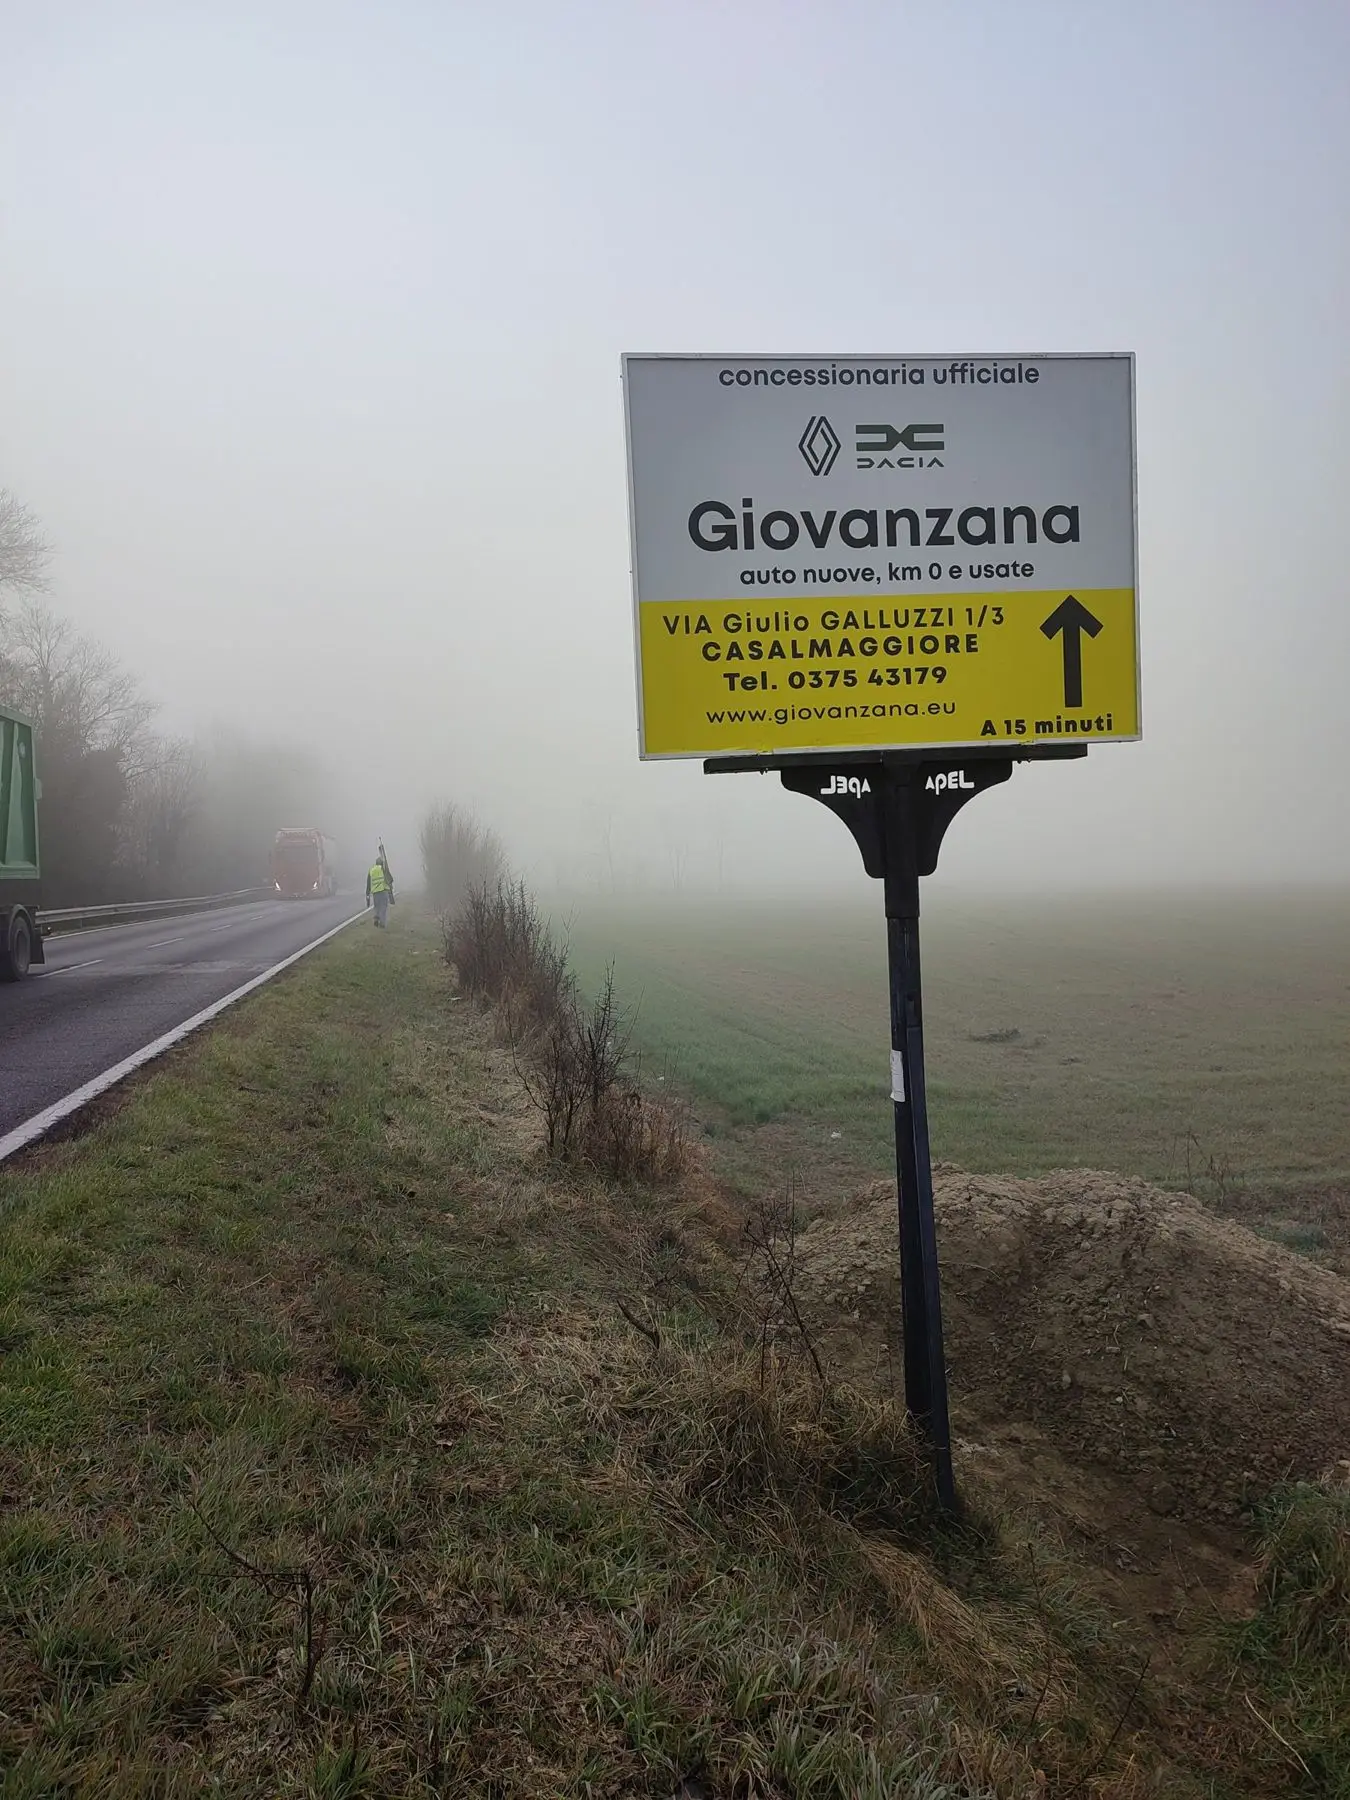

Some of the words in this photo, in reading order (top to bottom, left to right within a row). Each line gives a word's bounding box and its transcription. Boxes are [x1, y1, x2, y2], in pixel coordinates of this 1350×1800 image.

[718, 363, 925, 387] concessionaria
[932, 363, 1040, 385] ufficiale
[856, 457, 945, 470] DACIA
[687, 498, 1080, 552] Giovanzana
[739, 567, 797, 586] auto
[803, 568, 881, 585] nuove,
[888, 562, 922, 581] km
[928, 563, 942, 581] 0
[948, 565, 963, 580] e
[969, 561, 1035, 579] usate
[662, 615, 713, 635] VIA
[723, 611, 810, 634] Giulio
[820, 608, 954, 631] GALLUZZI
[965, 605, 1004, 628] 1/3
[701, 634, 979, 662] CASALMAGGIORE
[722, 671, 778, 692] Tel.
[787, 670, 858, 690] 0375
[867, 667, 947, 687] 43179
[706, 703, 956, 725] www.giovanzana.eu
[980, 720, 997, 737] A
[1003, 720, 1027, 735] 15
[1034, 714, 1113, 734] minuti
